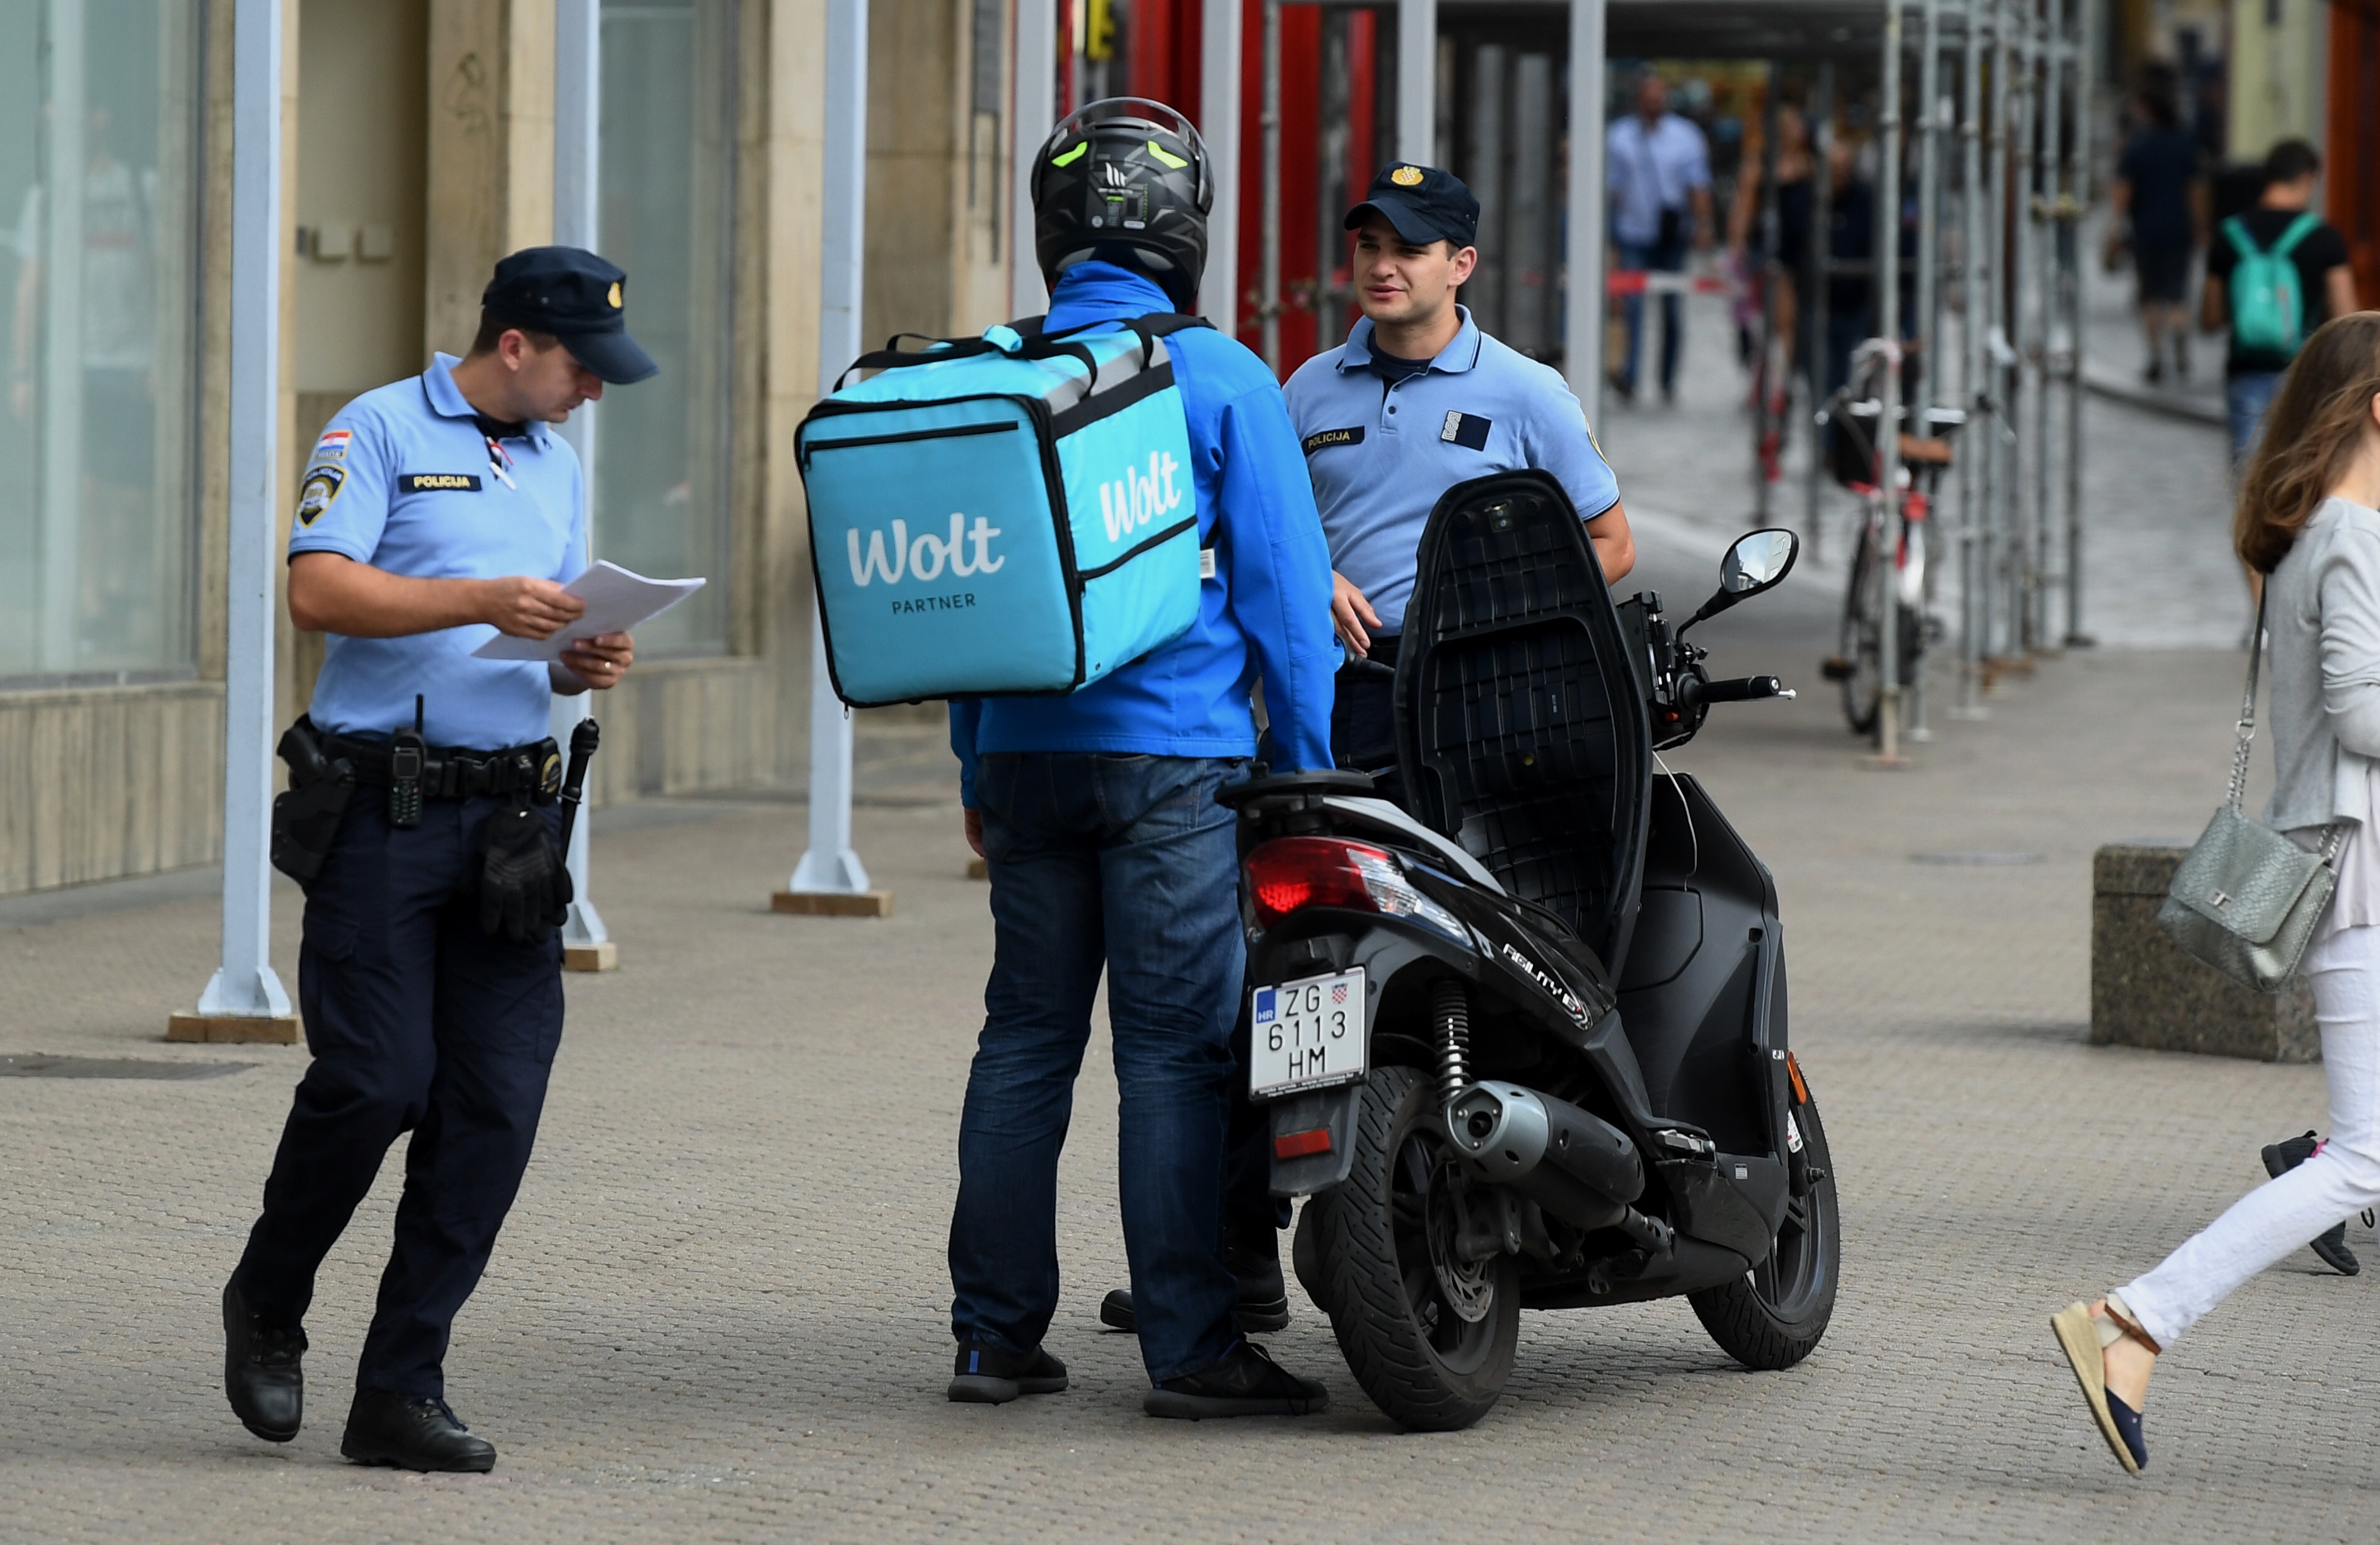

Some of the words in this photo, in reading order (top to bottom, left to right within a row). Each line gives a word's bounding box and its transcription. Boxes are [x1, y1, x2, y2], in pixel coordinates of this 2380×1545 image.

[1308, 431, 1350, 449] POLICIJA
[413, 476, 471, 488] POLICIJA
[1099, 451, 1182, 543] Wolt
[847, 512, 1005, 586] Wolt
[892, 593, 976, 614] PARTNER
[1503, 943, 1563, 995] AGILITY
[1257, 1009, 1274, 1021] HR
[1285, 985, 1320, 1018] ZG
[1269, 1011, 1346, 1052] 6113
[1289, 1045, 1325, 1079] HM
